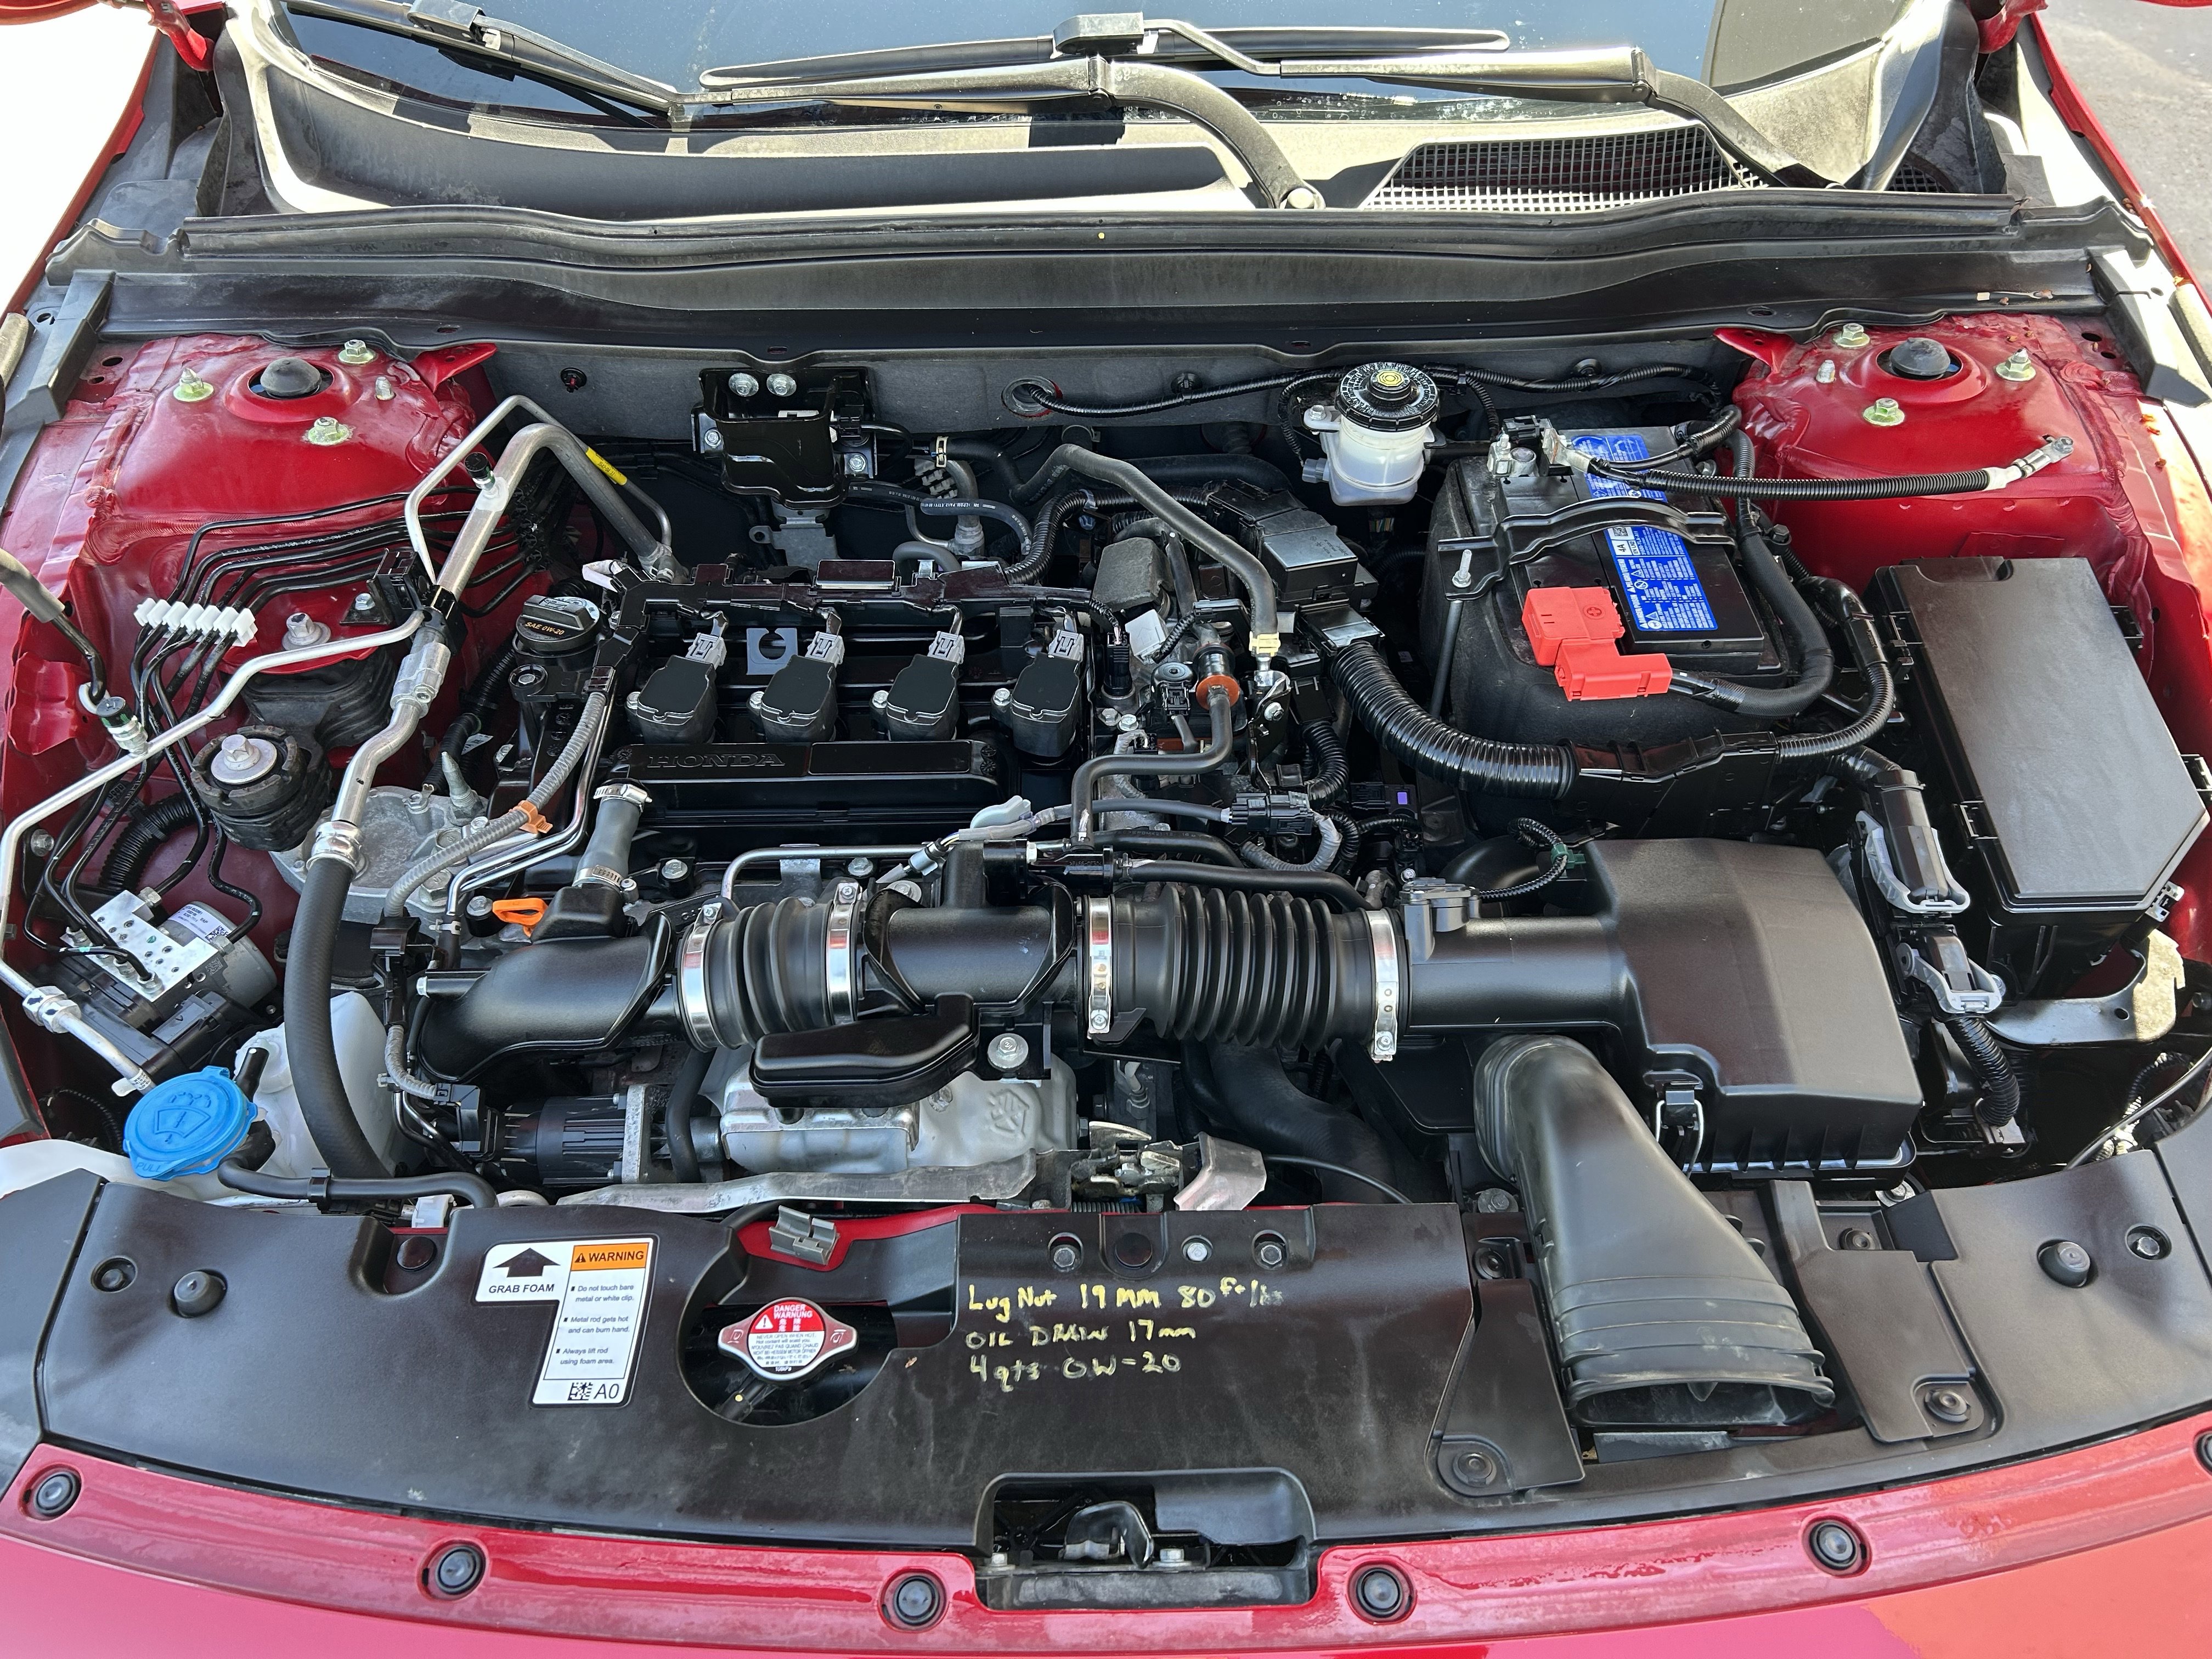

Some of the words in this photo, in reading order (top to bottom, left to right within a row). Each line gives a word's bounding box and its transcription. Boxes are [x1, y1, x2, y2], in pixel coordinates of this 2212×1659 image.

[1617, 544, 1626, 552] 4A
[541, 625, 565, 635] 0W-20
[647, 753, 785, 768] HONDA
[136, 1162, 161, 1172] PULL
[589, 1251, 644, 1262] WARNING
[489, 1284, 520, 1294] GRAB
[523, 1284, 555, 1293] FOAM
[774, 1304, 806, 1312] DANGER
[969, 1284, 1010, 1323] Lug
[1018, 1285, 1057, 1308] Nut
[1080, 1284, 1107, 1309] 19
[1177, 1285, 1216, 1308] 80
[774, 1311, 812, 1319] WARNUNG
[965, 1331, 1013, 1350] OIL
[1029, 1323, 1109, 1347] DRAIN
[1128, 1319, 1154, 1342] 17
[970, 1355, 987, 1382] 4
